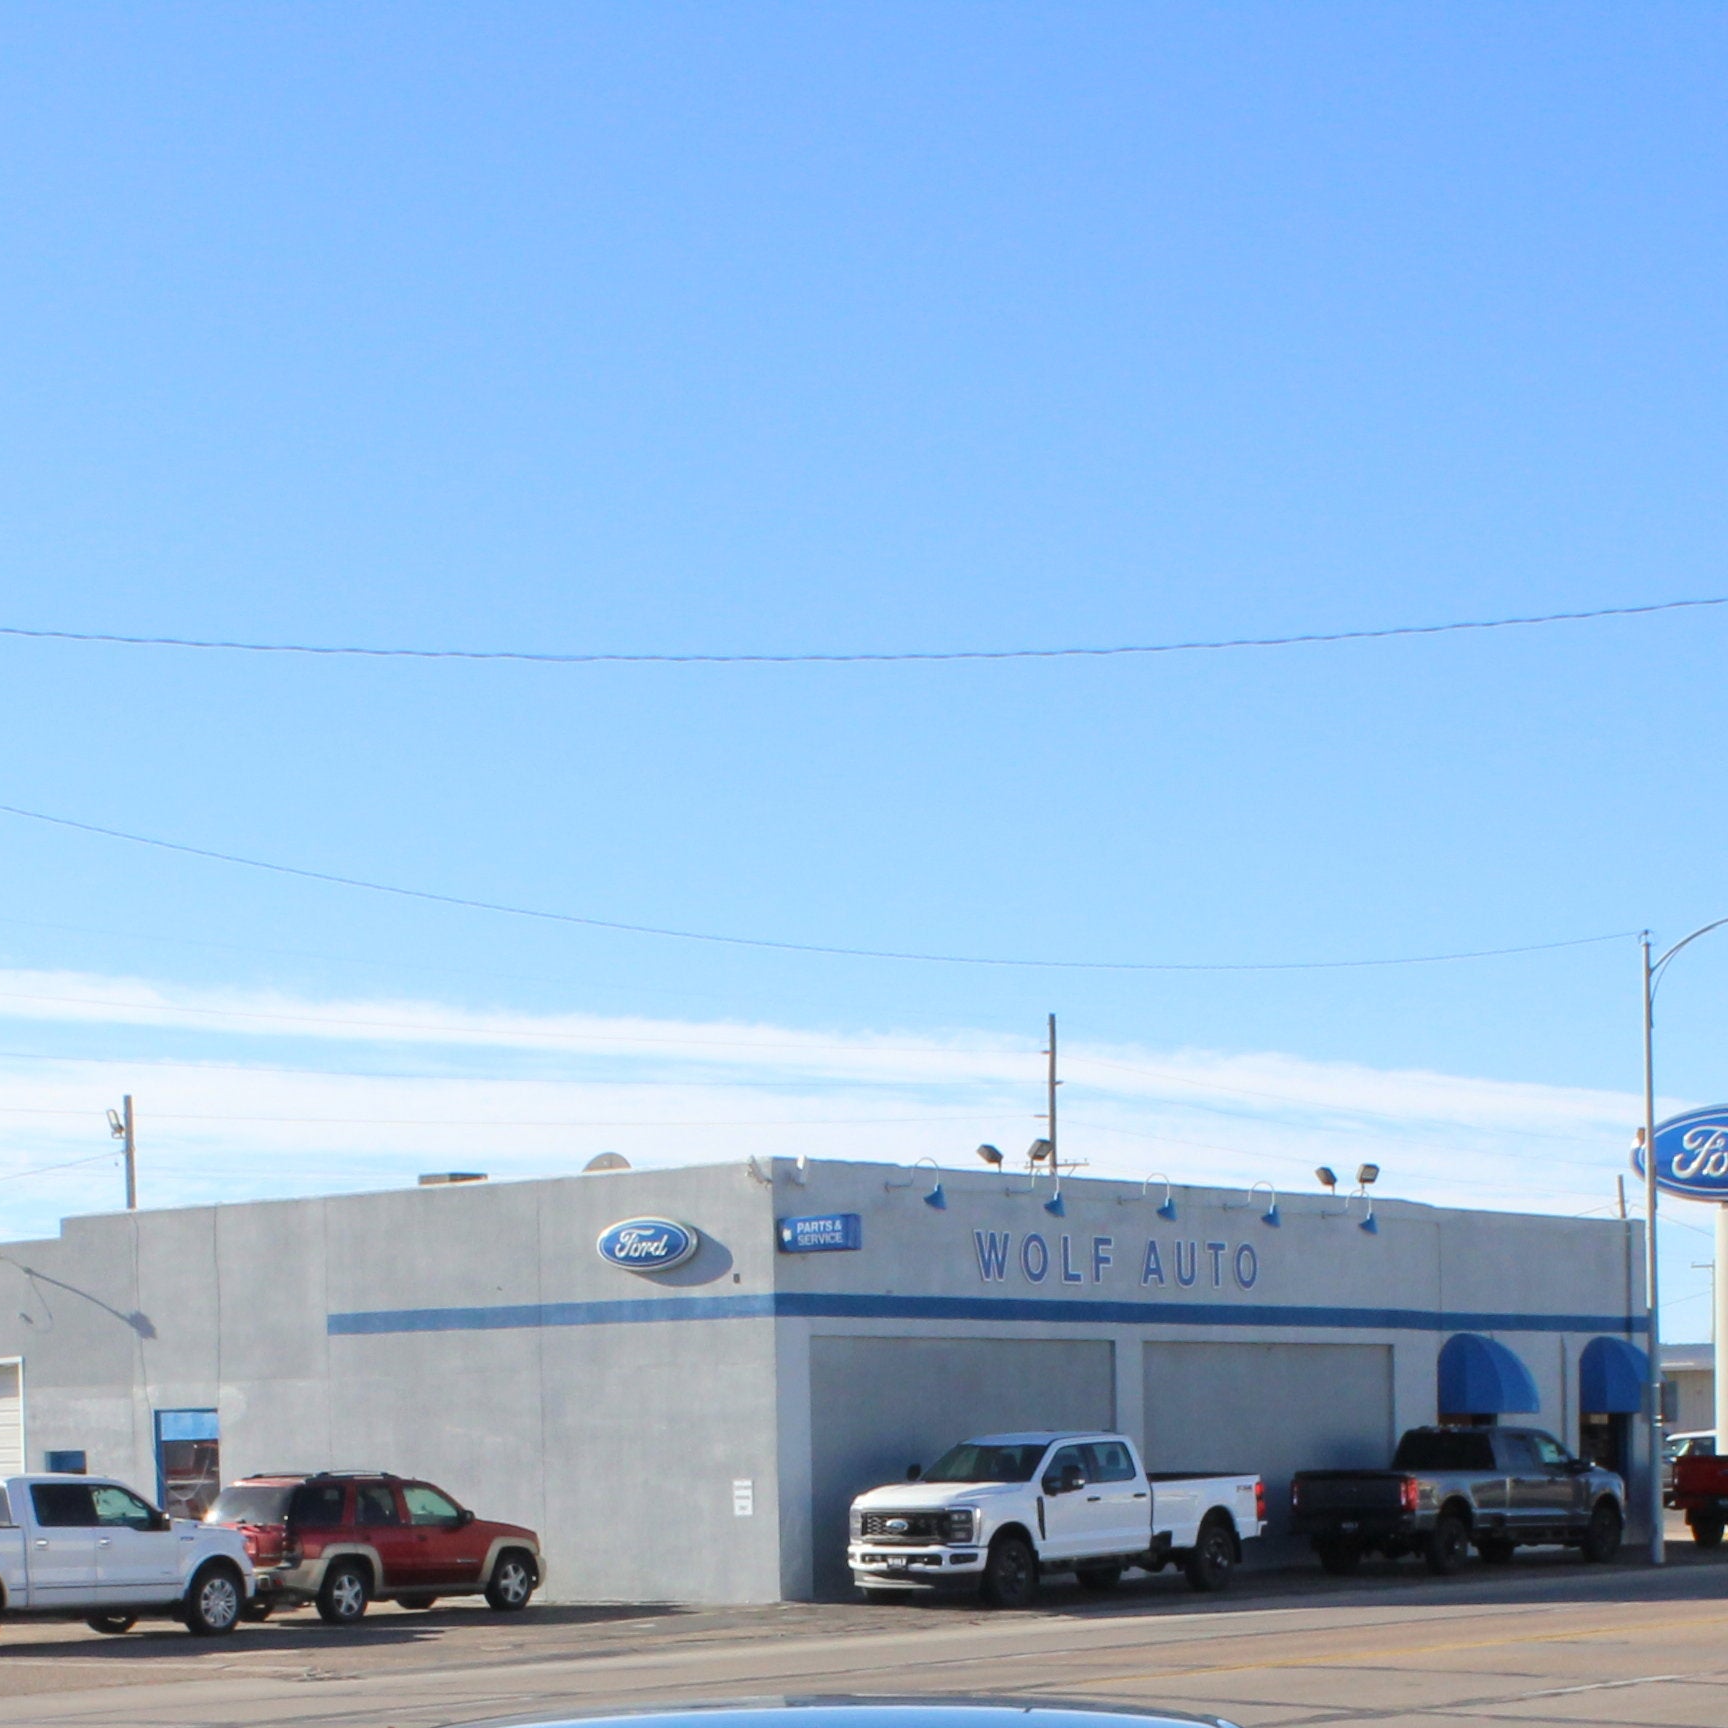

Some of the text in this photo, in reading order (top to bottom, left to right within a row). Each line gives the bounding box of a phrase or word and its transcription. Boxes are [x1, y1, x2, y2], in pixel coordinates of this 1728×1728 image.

[797, 1221, 832, 1233] PARTS
[615, 1228, 668, 1258] Ford
[797, 1232, 843, 1246] SERVICE
[974, 1229, 1259, 1291] WOLF AUTO
